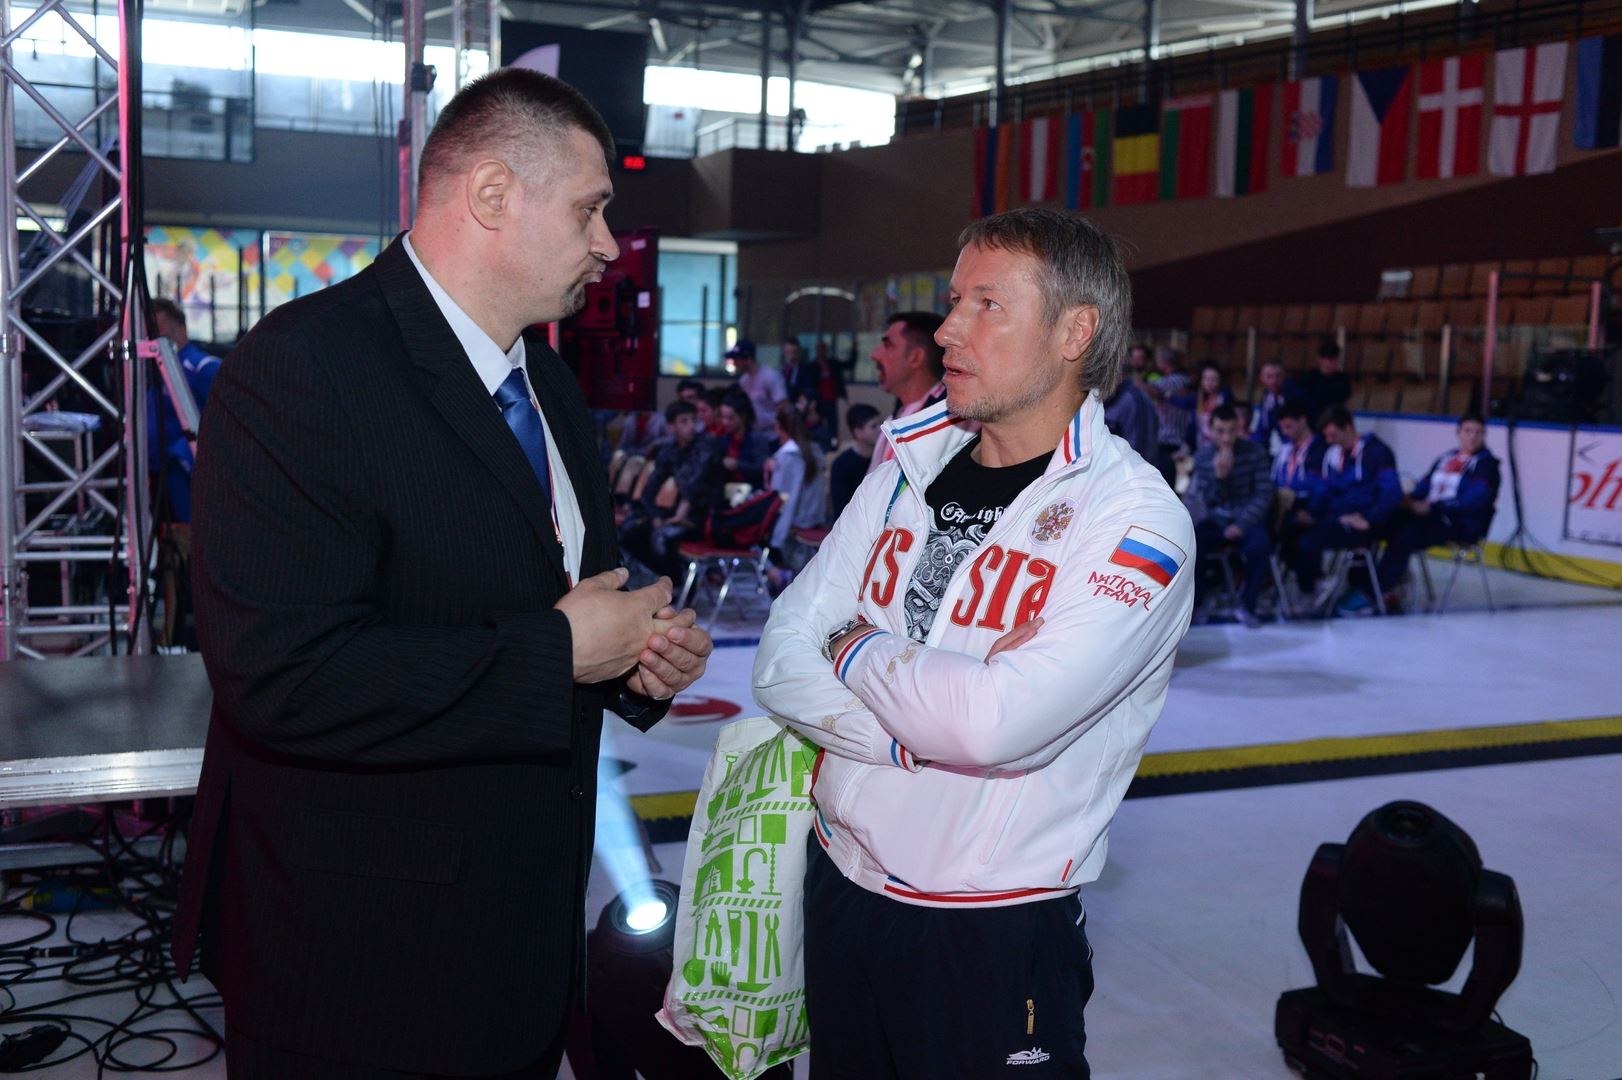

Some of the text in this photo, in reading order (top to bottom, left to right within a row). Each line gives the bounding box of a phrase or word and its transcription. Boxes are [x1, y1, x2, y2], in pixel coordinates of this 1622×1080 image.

[1087, 571, 1153, 611] NATIONAL
[1093, 584, 1138, 608] TEAM
[1006, 1055, 1050, 1065] FORWARD
